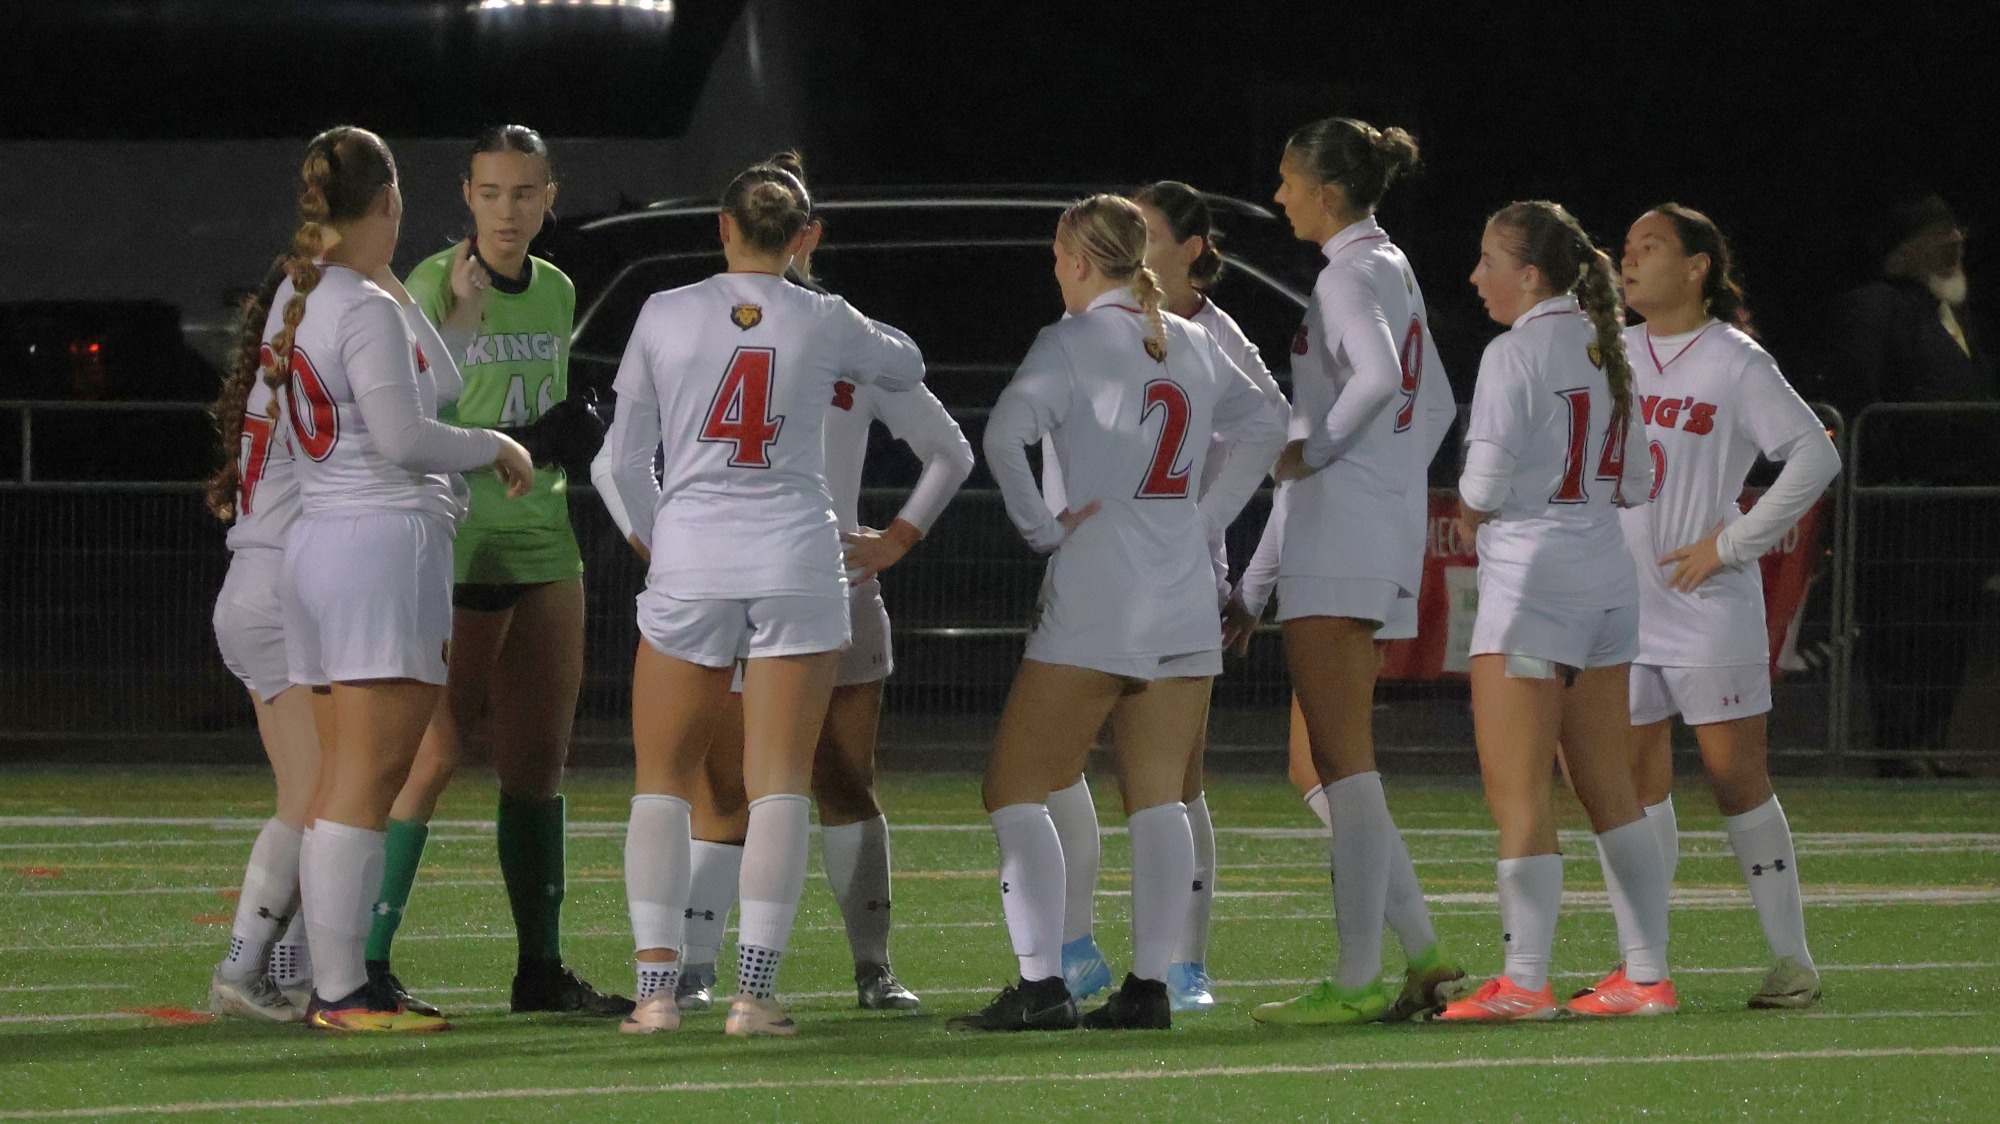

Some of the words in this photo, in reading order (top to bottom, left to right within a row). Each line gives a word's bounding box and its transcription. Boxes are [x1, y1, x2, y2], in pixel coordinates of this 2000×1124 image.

[697, 345, 786, 469] 4
[1394, 312, 1424, 434] 9
[1133, 378, 1194, 499] 2
[1548, 386, 1633, 504] 14
